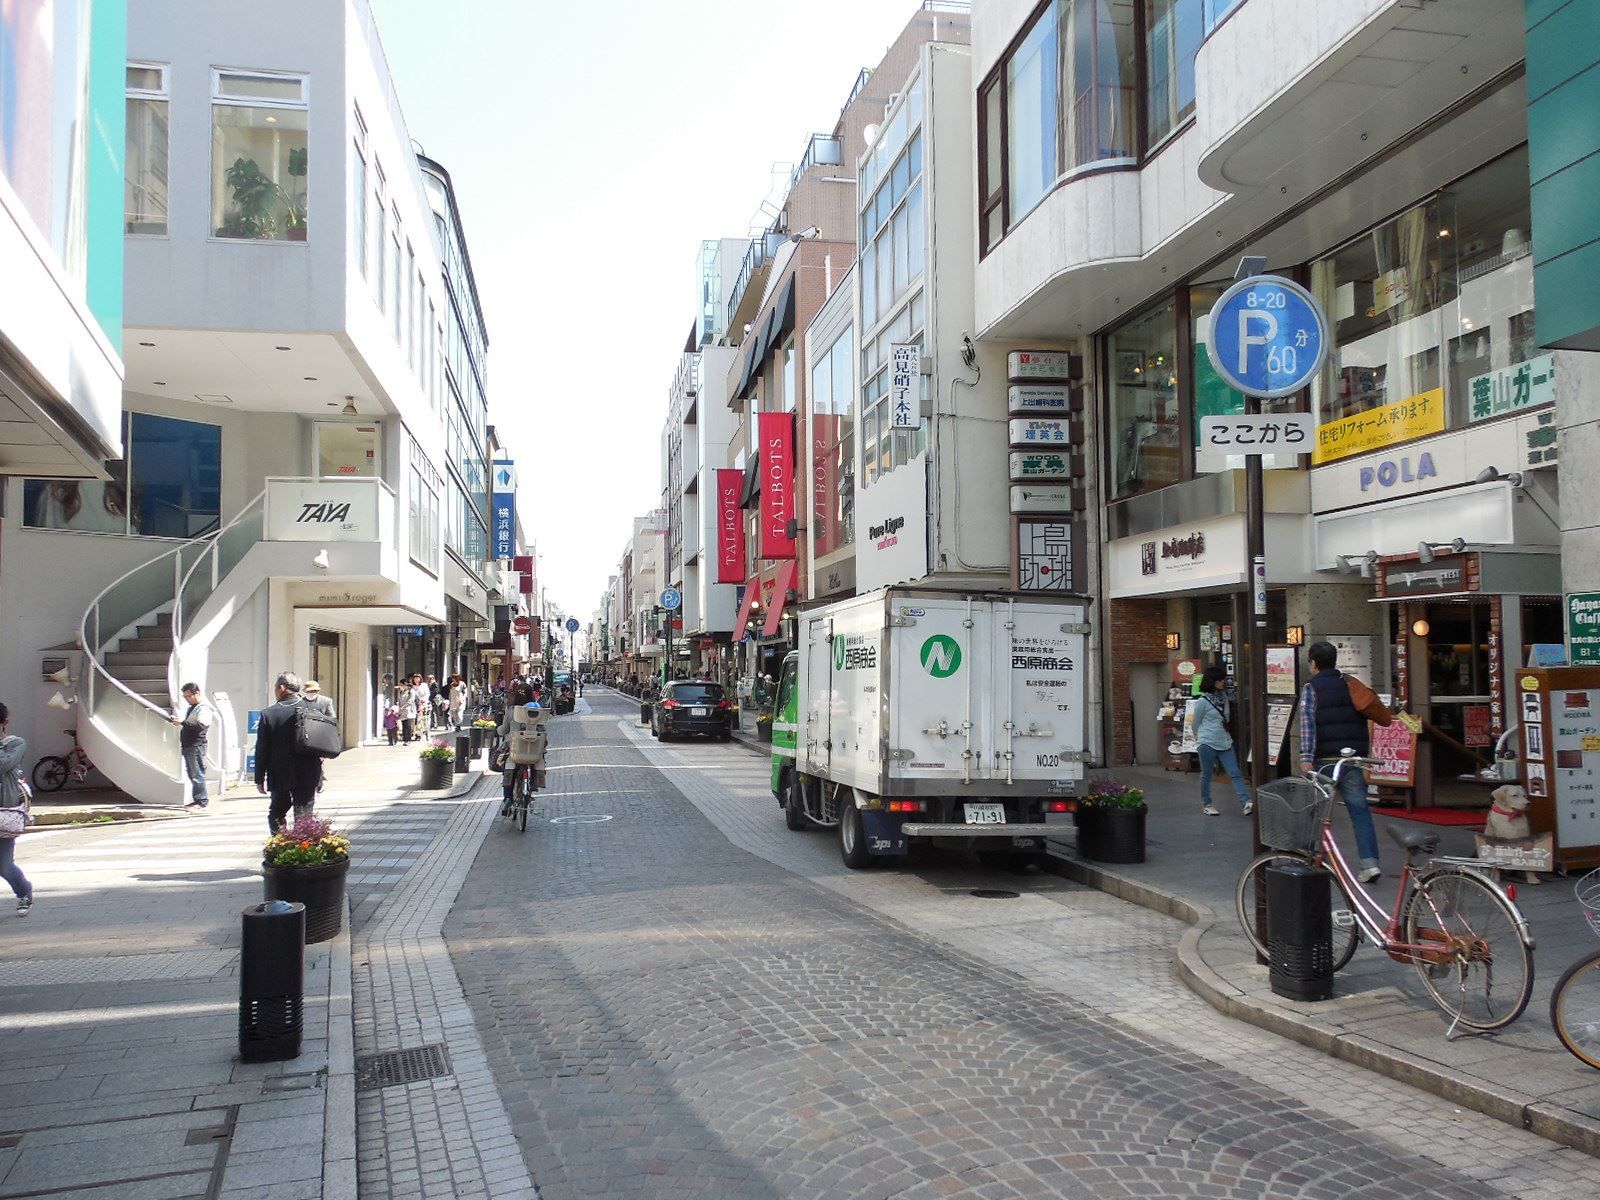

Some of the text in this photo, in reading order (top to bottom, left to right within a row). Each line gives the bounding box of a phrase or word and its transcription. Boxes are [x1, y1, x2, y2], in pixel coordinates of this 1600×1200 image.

[1247, 292, 1286, 308] 8-20
[1238, 309, 1278, 374] P
[1295, 329, 1309, 347] 分
[1267, 345, 1297, 374] 60
[894, 347, 911, 425] 高見硝子本社
[1473, 357, 1555, 418] 葉山ガー
[1025, 429, 1064, 440] 理英会
[1211, 422, 1305, 444] ここから
[1320, 397, 1435, 446] 住宅リフォーム承ります。
[1360, 452, 1438, 491] POLA
[769, 438, 784, 537] TALBOTS
[296, 503, 351, 522] TAYA
[725, 488, 736, 565] TALBOTS
[498, 507, 510, 552] 横浜銀行
[846, 645, 877, 670] 西原商会
[1011, 656, 1073, 670] 西原商会
[1488, 633, 1501, 728] オリジナル家具
[1036, 754, 1059, 767] NO.20
[1372, 747, 1399, 759] MAX
